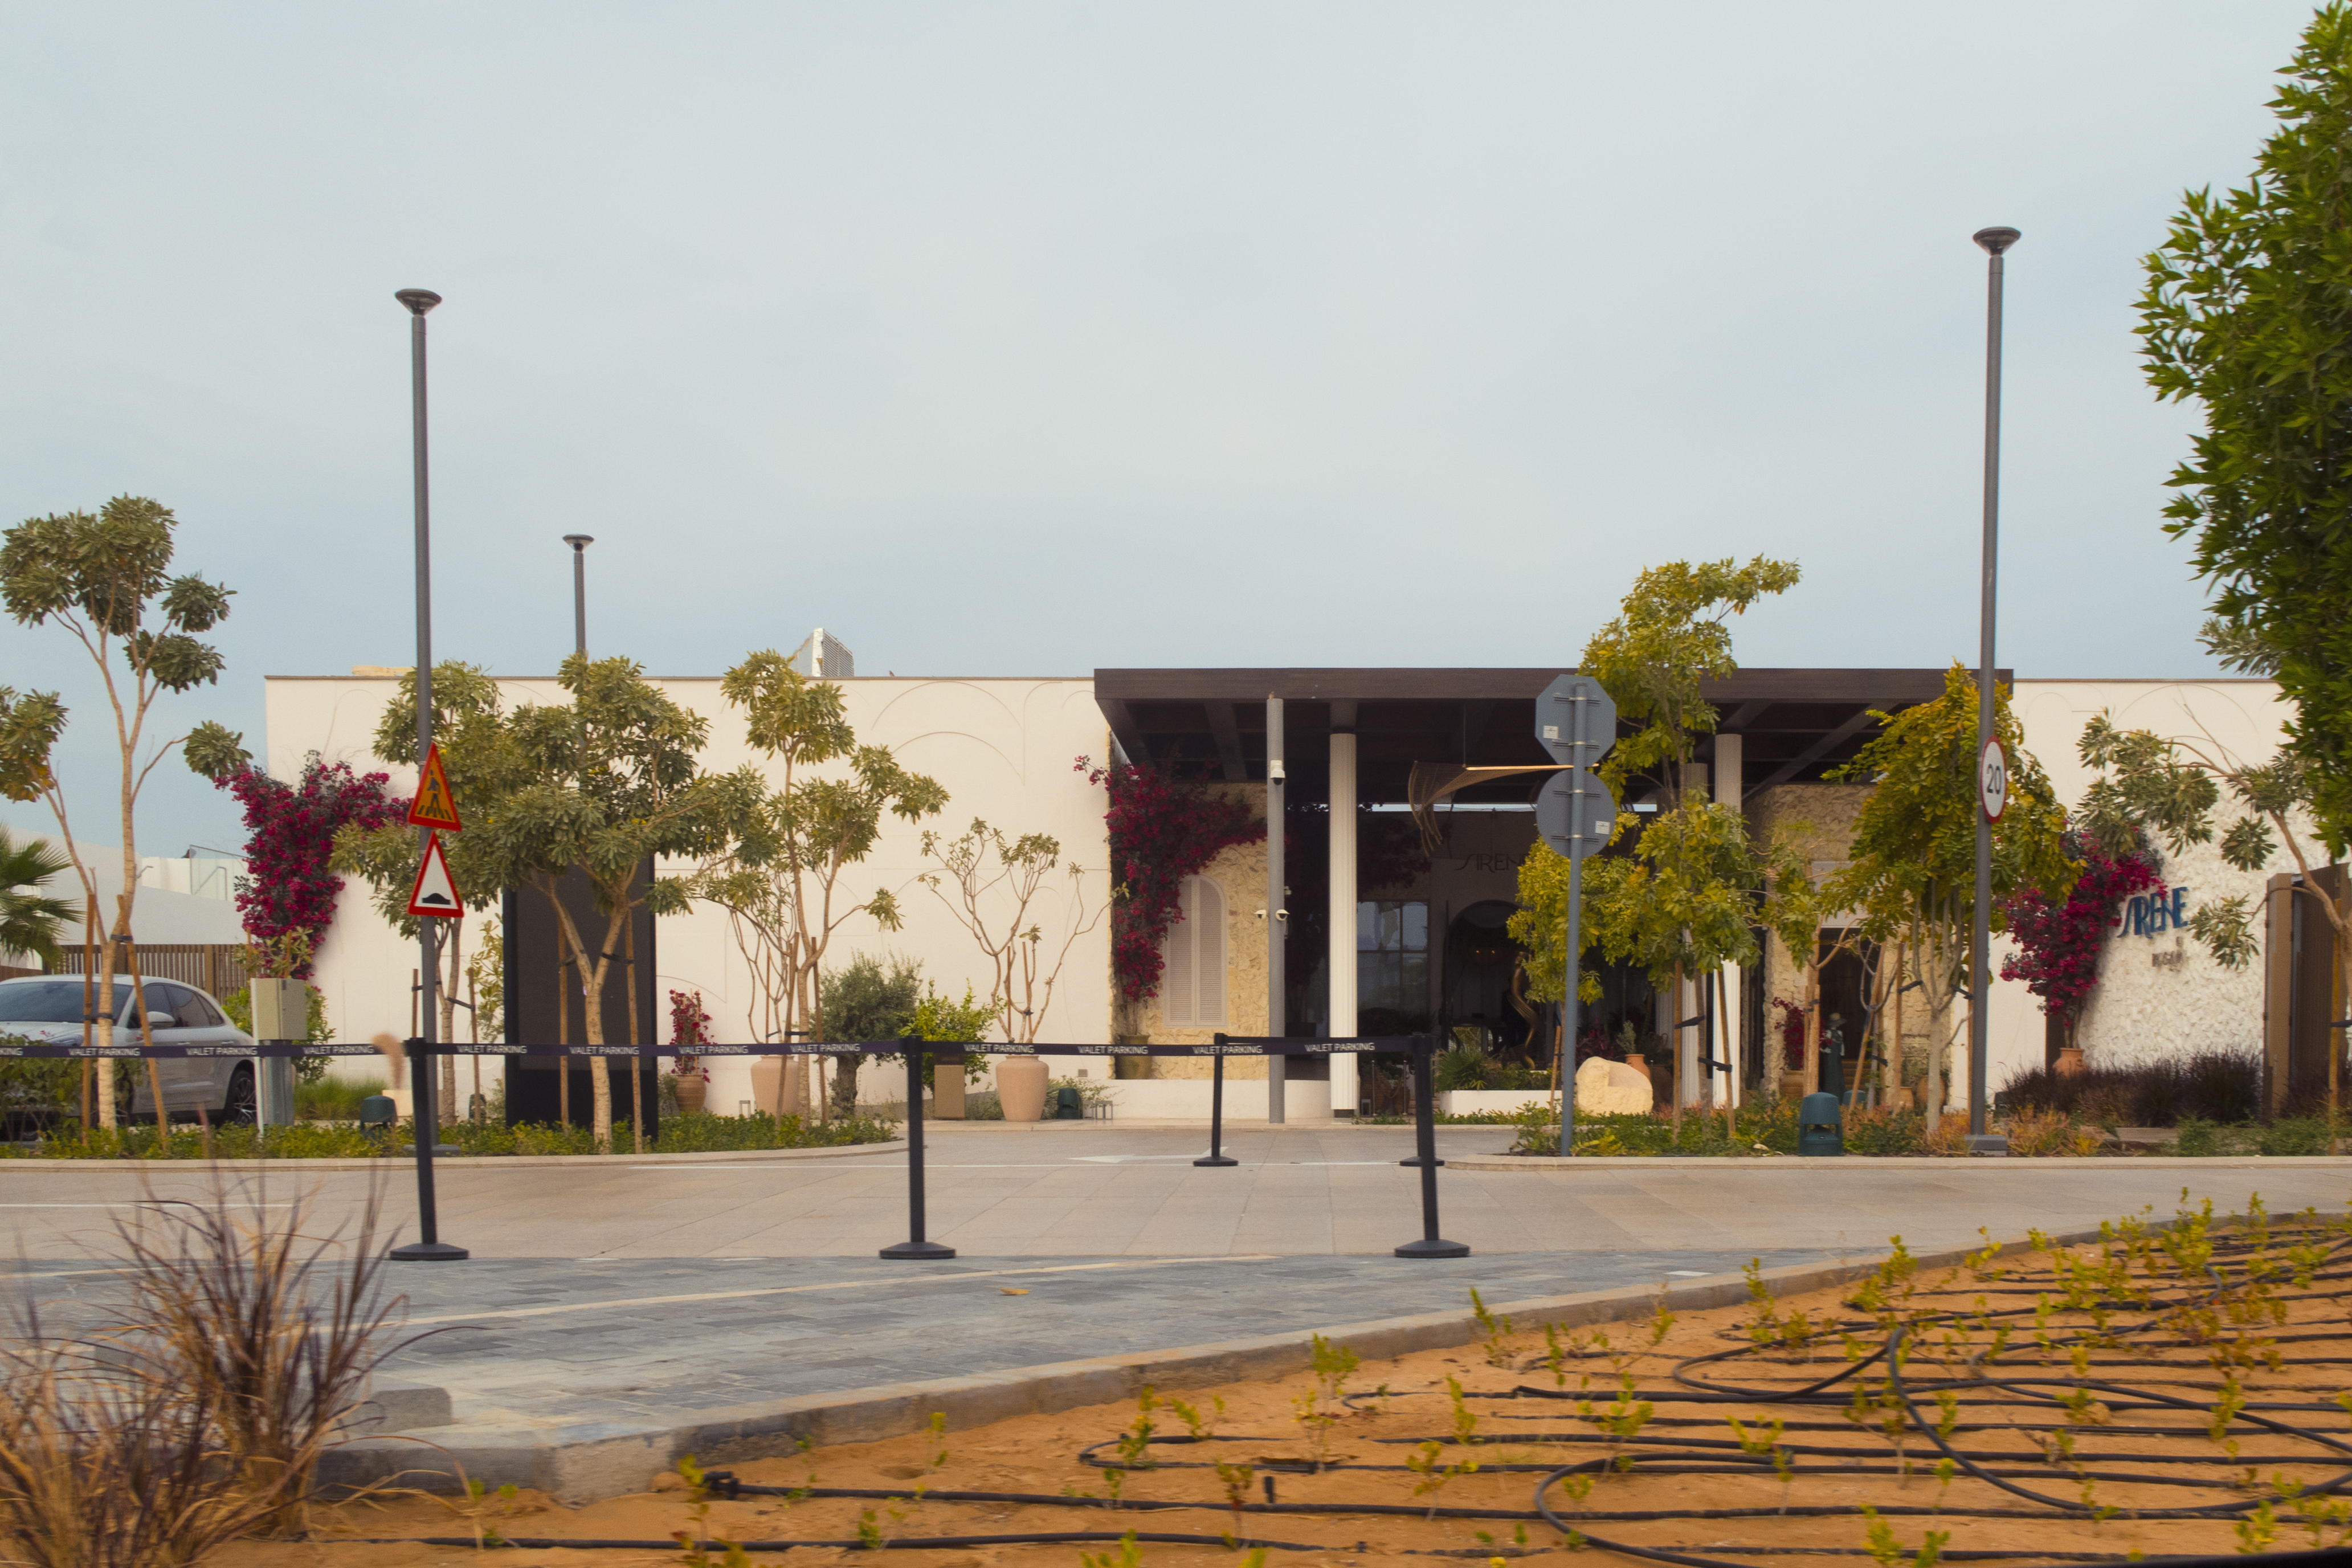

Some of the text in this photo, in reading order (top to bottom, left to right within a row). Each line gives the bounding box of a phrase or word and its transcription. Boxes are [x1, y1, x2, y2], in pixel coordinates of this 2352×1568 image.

[1986, 763, 2002, 795] 20
[486, 1045, 527, 1054] PARKING
[820, 1043, 860, 1052] PARKING
[993, 1044, 1034, 1053] PARKING
